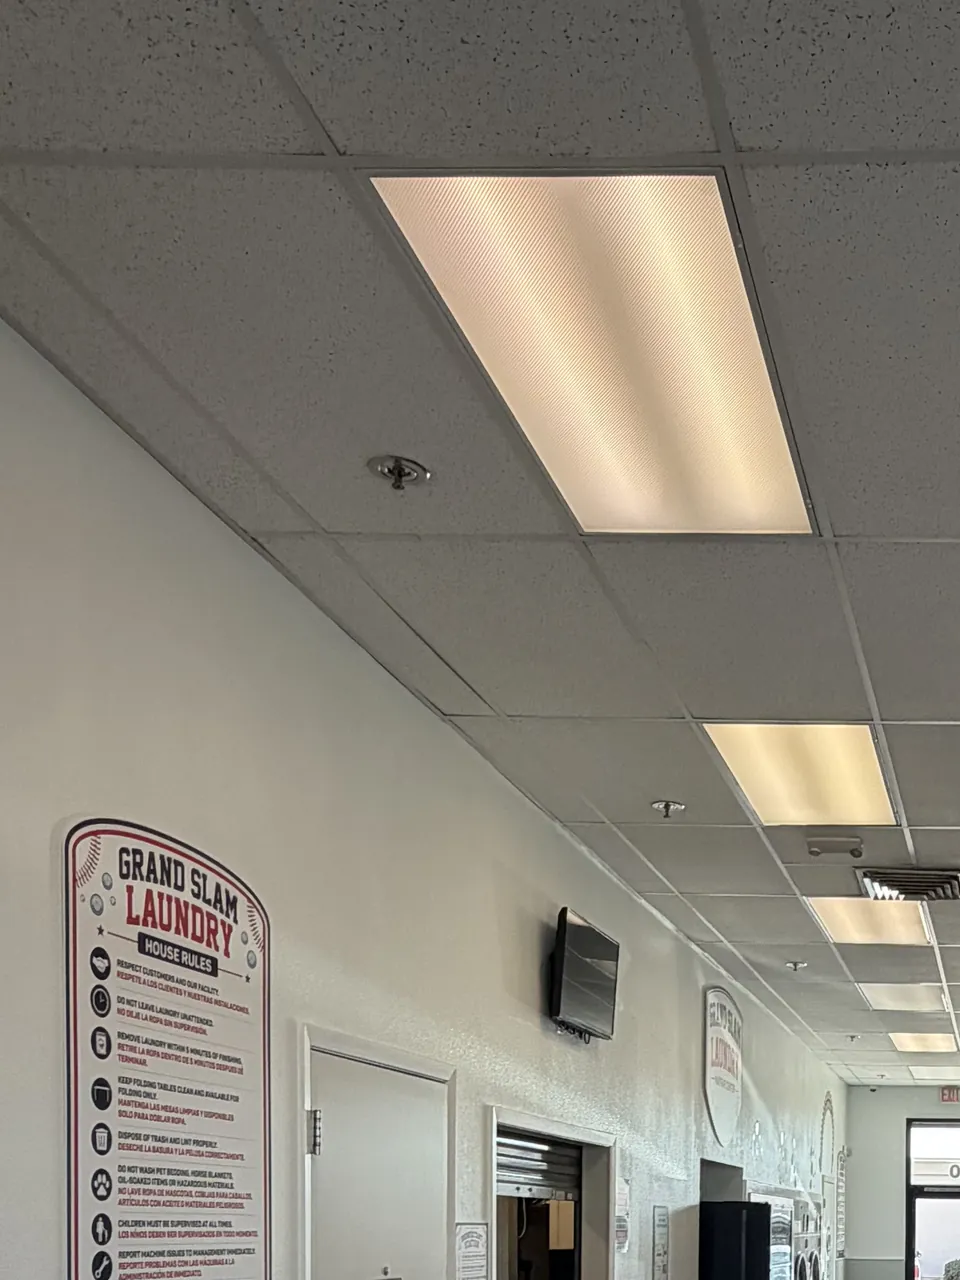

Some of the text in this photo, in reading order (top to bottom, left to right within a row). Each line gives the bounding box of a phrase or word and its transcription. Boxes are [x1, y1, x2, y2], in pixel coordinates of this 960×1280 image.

[119, 847, 238, 925] GRAND SLAM
[126, 884, 233, 958] LAUNDRY
[145, 939, 213, 972] HOUSE RULES
